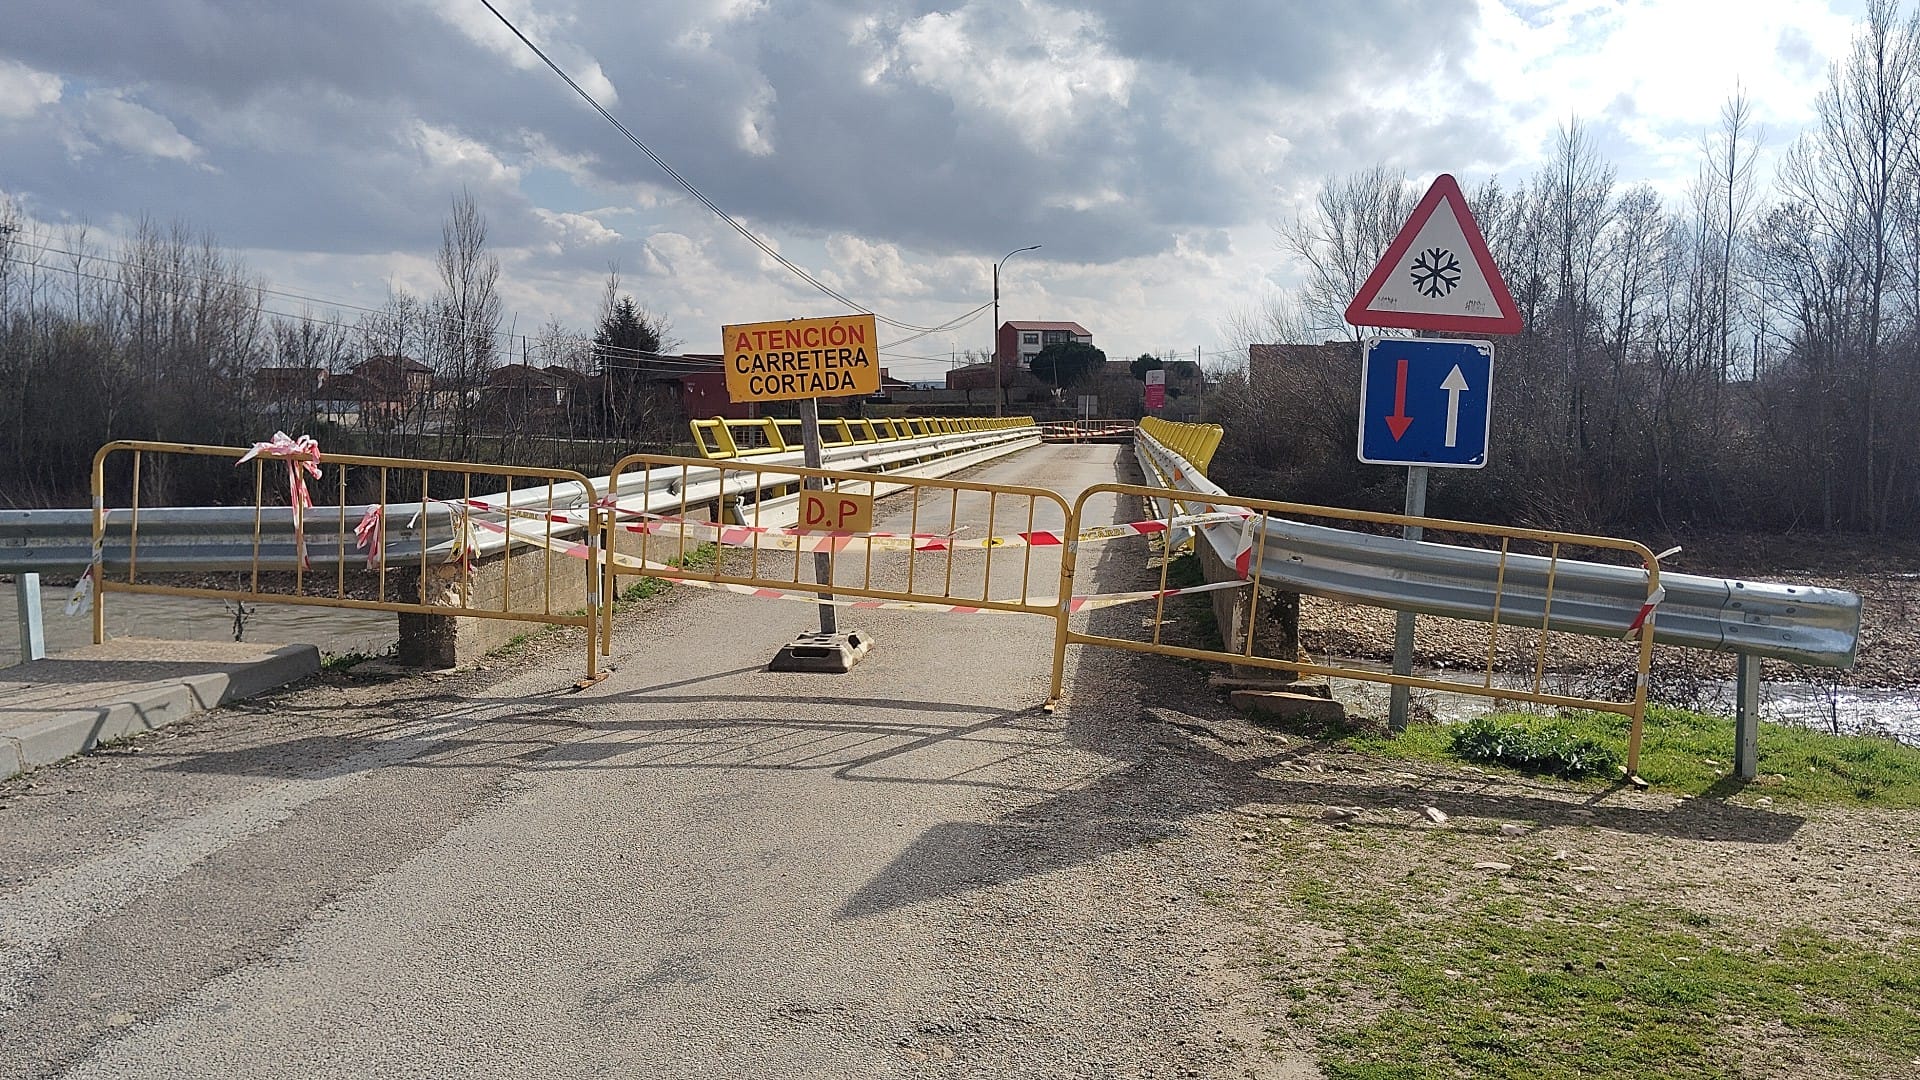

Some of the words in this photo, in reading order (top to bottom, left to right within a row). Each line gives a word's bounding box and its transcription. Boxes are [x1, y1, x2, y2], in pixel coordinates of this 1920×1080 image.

[735, 321, 865, 352] ATENCIÓN
[735, 347, 869, 374] CARRETERA
[750, 370, 856, 395] CORTADA
